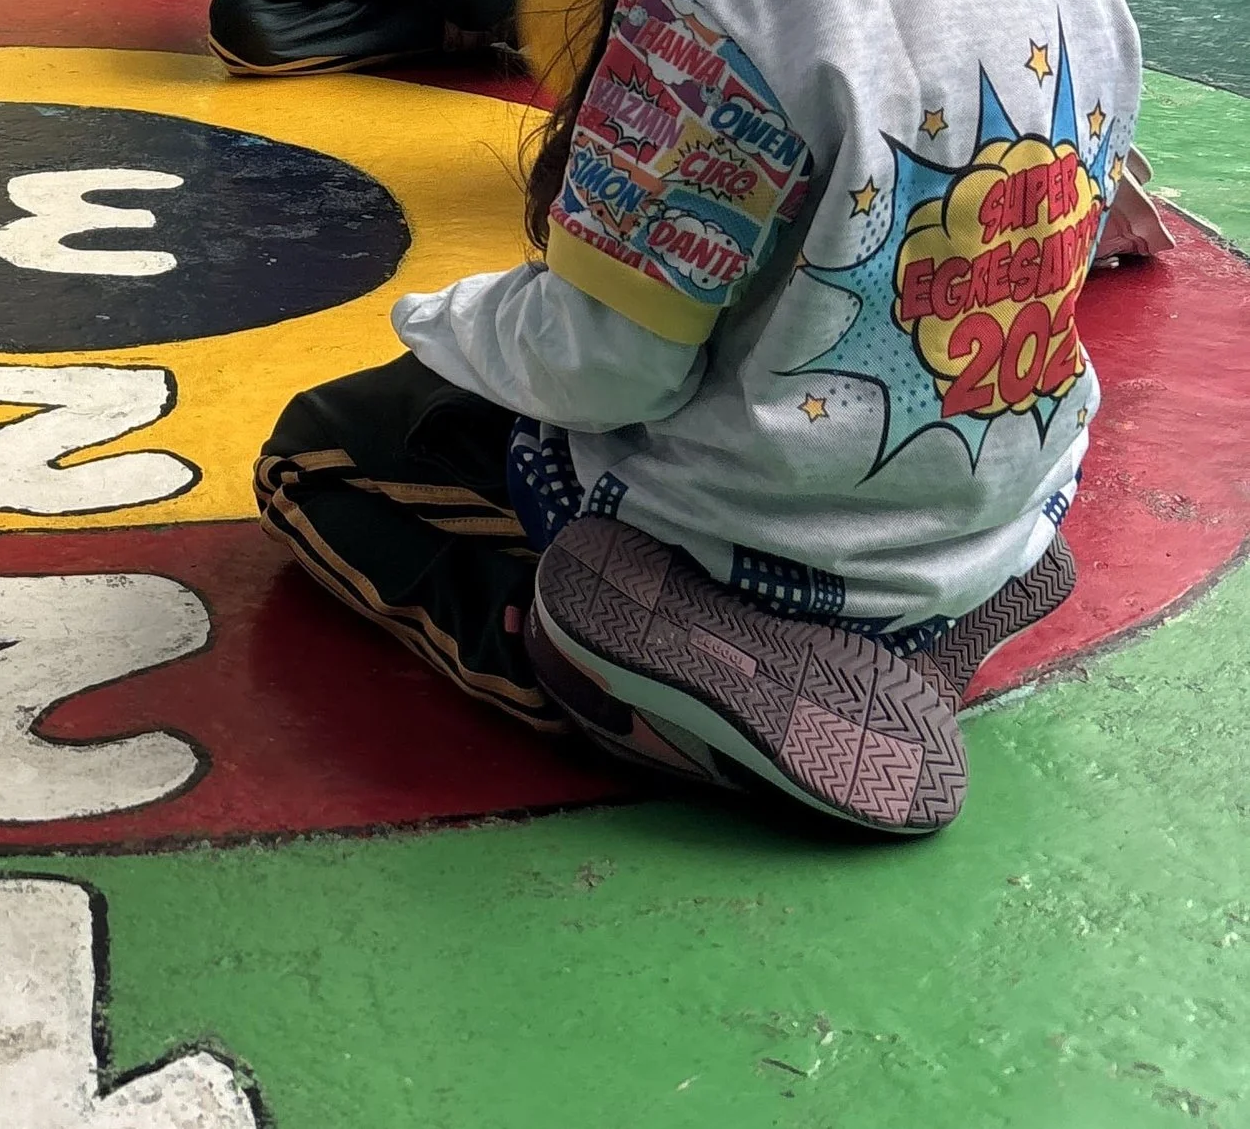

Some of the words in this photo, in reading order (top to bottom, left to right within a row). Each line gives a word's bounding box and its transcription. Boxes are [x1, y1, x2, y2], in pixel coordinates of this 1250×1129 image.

[632, 16, 726, 88] HANNA
[710, 102, 804, 167] OWEN
[570, 151, 647, 213] SIMON
[680, 151, 758, 195] CIRO
[978, 152, 1078, 245] SUPER
[647, 220, 750, 282] DANTE
[941, 288, 1086, 419] 202
